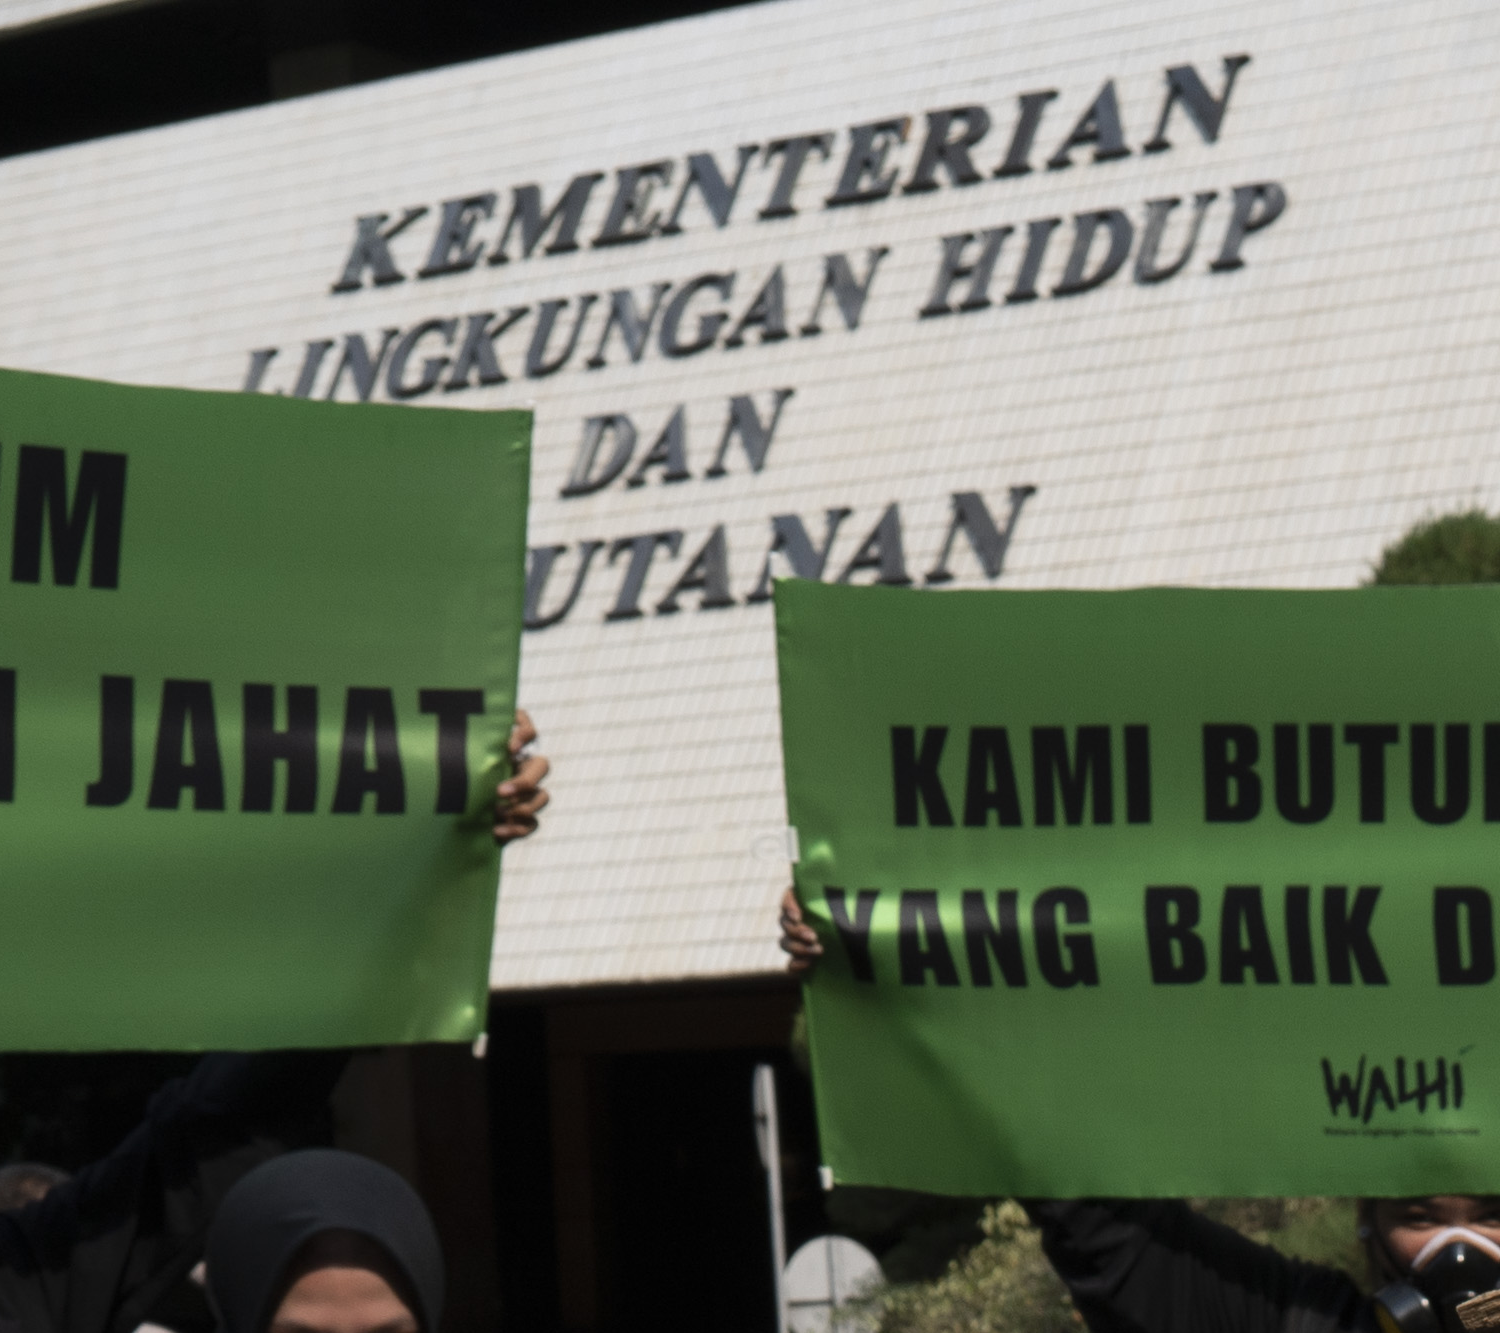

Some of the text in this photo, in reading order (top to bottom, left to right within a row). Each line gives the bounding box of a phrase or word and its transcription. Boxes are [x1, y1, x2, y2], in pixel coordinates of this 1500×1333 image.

[330, 53, 1252, 294] KEMENTERIAN
[242, 181, 1289, 401] LINGKUNGAN HIDUP
[559, 388, 796, 500] DAN
[84, 672, 487, 817] JAHAT
[889, 722, 1153, 828] KAMI
[821, 885, 1102, 991] YANG
[1143, 884, 1390, 987] BAIK
[1320, 1054, 1464, 1124] WALHI
